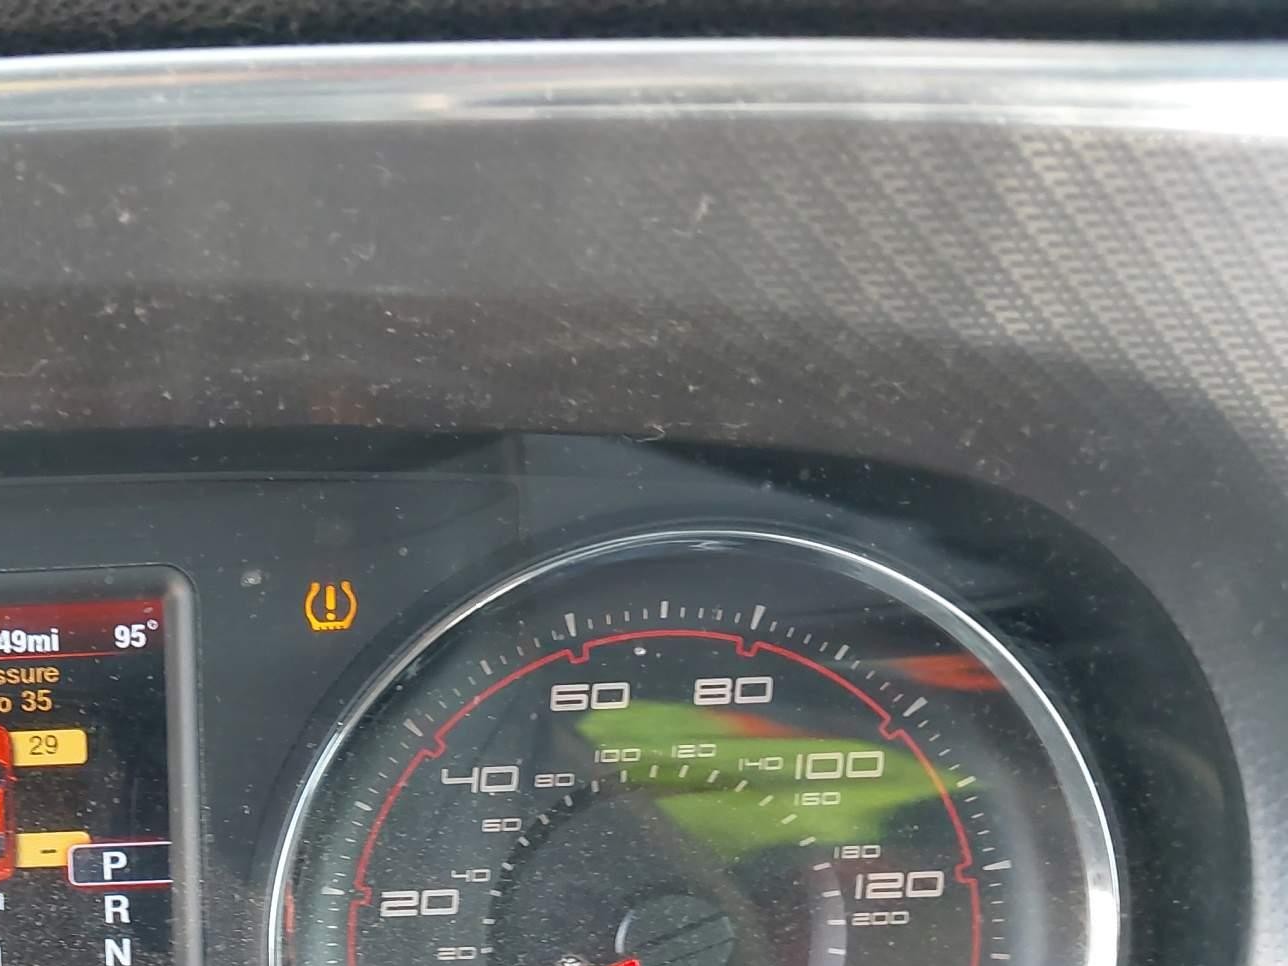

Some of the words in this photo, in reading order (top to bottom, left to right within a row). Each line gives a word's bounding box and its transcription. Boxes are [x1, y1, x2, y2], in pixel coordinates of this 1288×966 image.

[21, 690, 53, 712] 35
[550, 681, 630, 711] 60
[693, 676, 774, 705] 80
[29, 735, 59, 756] 29
[594, 748, 641, 764] 100
[669, 743, 717, 759] 120
[738, 755, 783, 771] 140
[794, 751, 884, 780] 100
[442, 766, 519, 794] 40
[535, 772, 575, 788] 80
[794, 791, 841, 806] 160
[482, 818, 521, 833] 60
[834, 844, 880, 860] 180
[103, 851, 128, 880] P
[451, 868, 490, 883] 40
[855, 871, 944, 899] 120
[105, 895, 130, 923] R
[380, 890, 460, 917] 20
[851, 911, 909, 926] 200
[105, 939, 131, 966] N
[436, 946, 477, 960] 20
